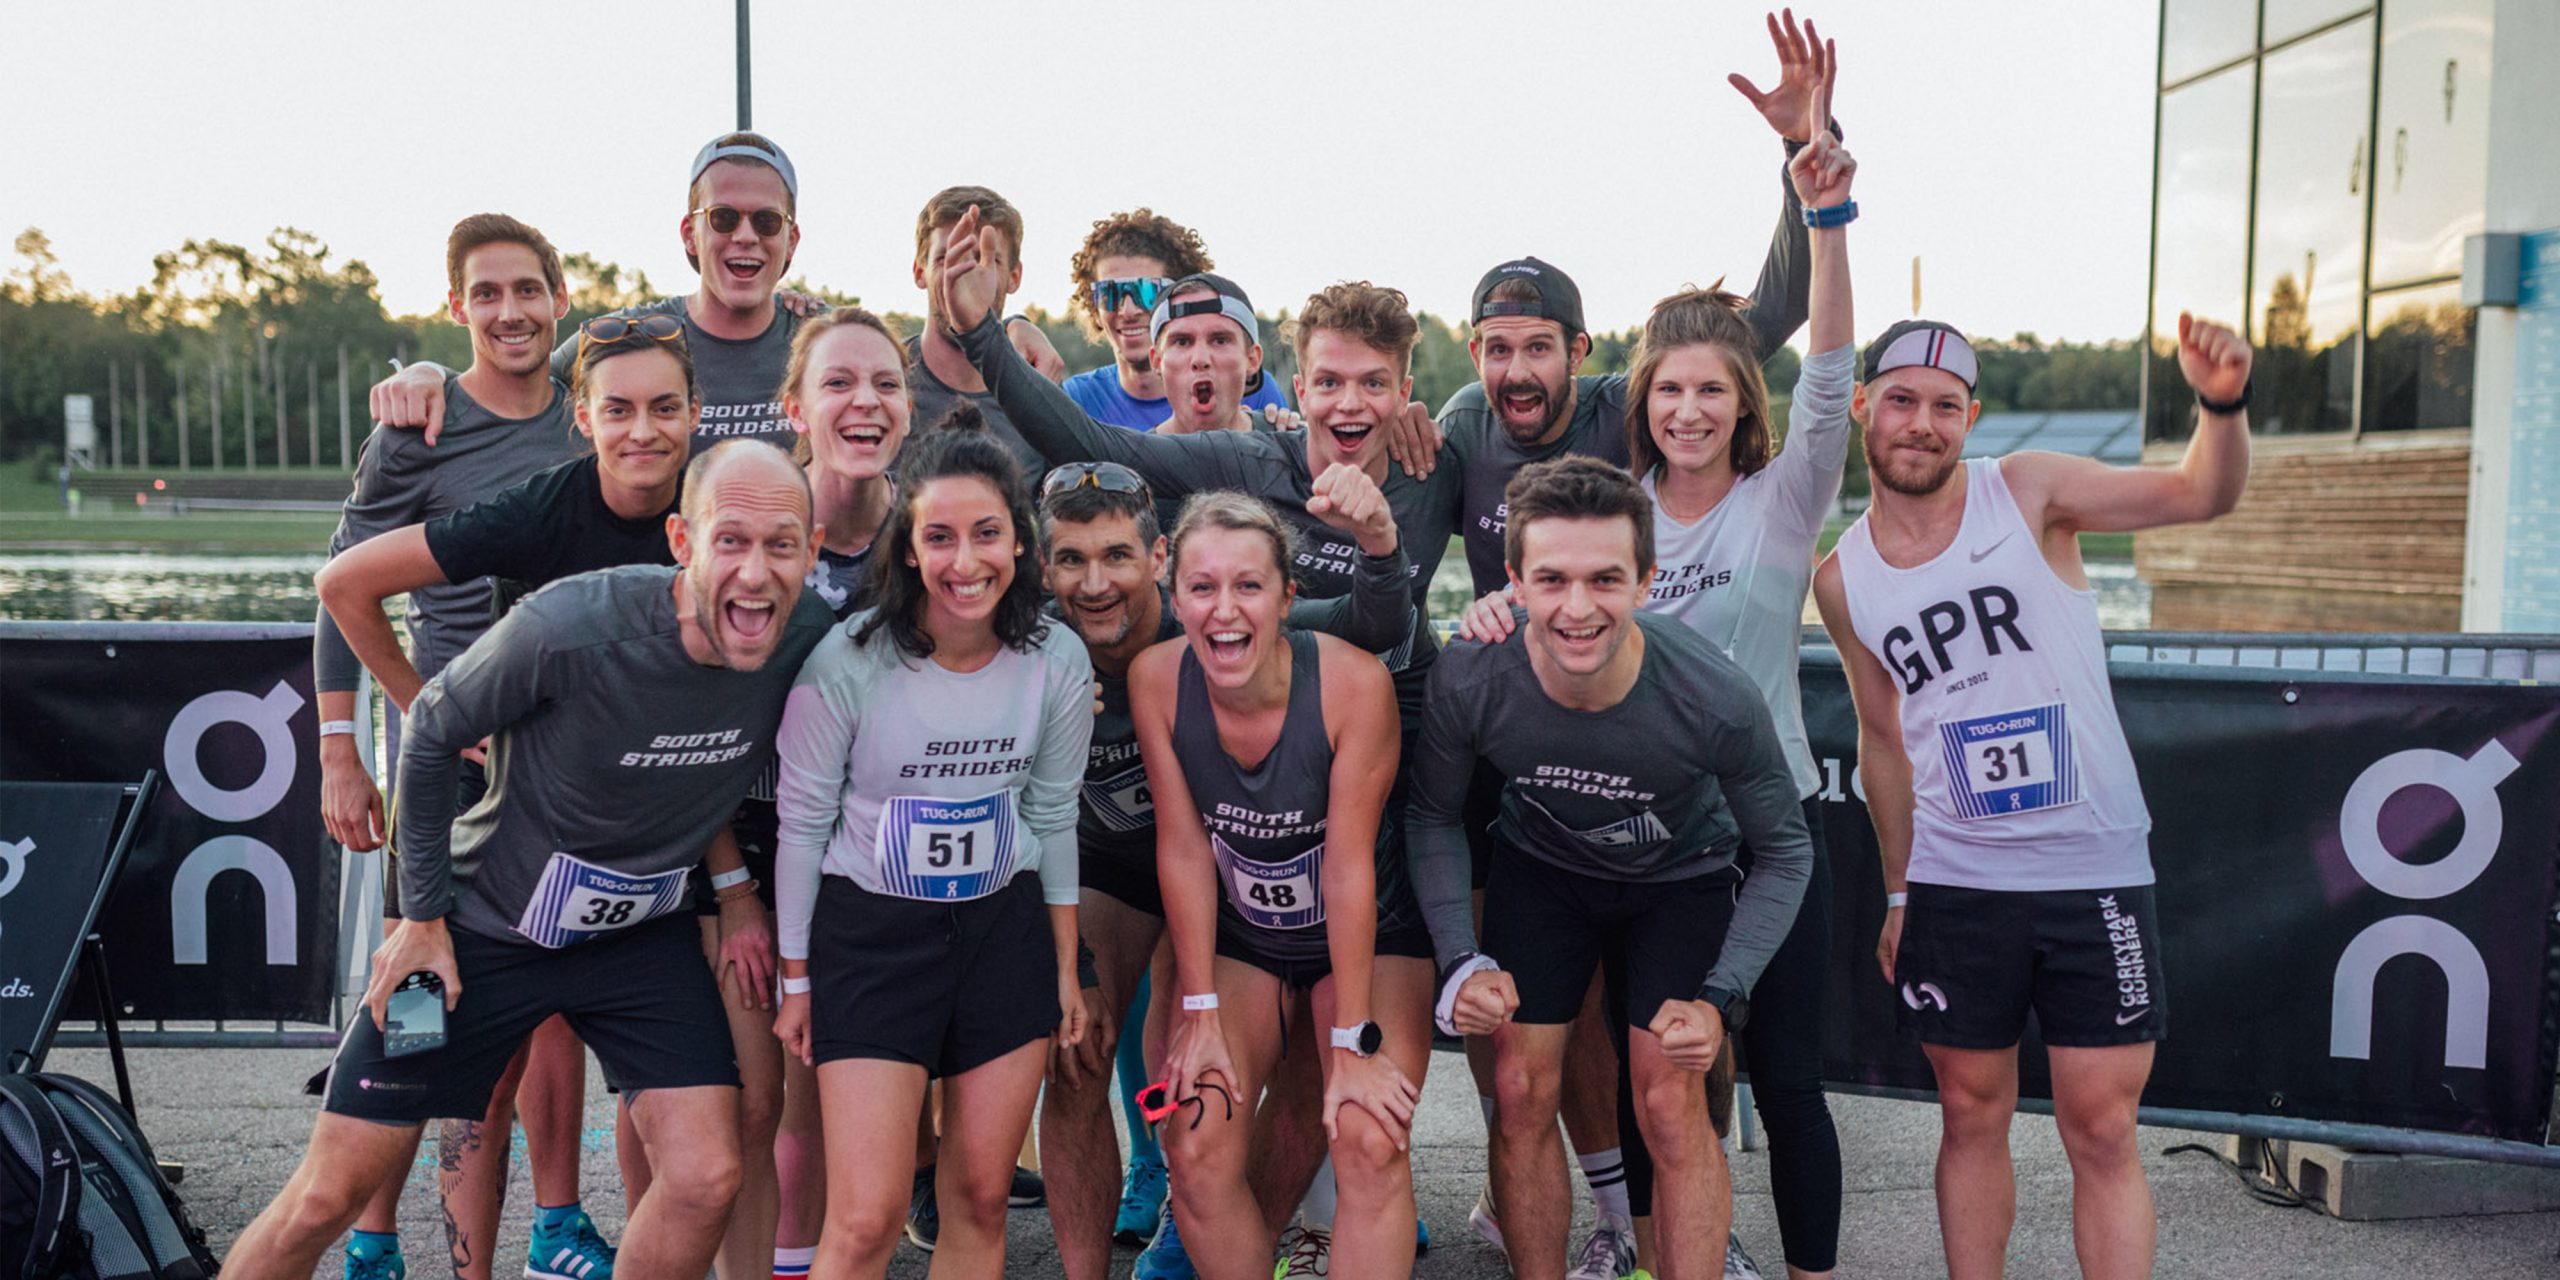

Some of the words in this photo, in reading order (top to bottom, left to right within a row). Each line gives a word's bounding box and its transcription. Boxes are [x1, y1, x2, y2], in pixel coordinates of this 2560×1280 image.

[700, 401, 785, 419] SOUTH
[697, 418, 793, 436] TRIDER
[1649, 570, 1732, 599] RIDERS
[1883, 585, 2035, 695] GPR
[1966, 671, 1989, 686] 2012
[1968, 716, 2036, 736] TUG-O-RUN
[650, 728, 742, 749] SOUTH
[925, 737, 1017, 756] SOUTH
[619, 741, 752, 767] STRIDERS
[1983, 741, 2031, 782] 31
[900, 755, 1034, 778] STRIDERS
[1535, 765, 1632, 787] SOUTH
[1134, 786, 1153, 805] 4
[1515, 776, 1656, 801] STRIDERS
[920, 804, 989, 820] TUG-O-RUN
[1215, 802, 1304, 826] SOUTH
[927, 830, 975, 868] 51
[1235, 859, 1298, 878] TUG-O-RUN
[588, 874, 657, 893] TUG-O-RUN
[1249, 882, 1296, 908] 48
[580, 898, 636, 926] 38
[2098, 894, 2137, 1008] GORKYPARK
[2121, 914, 2150, 1006] RUNNERS
[0, 978, 35, 998] ds.
